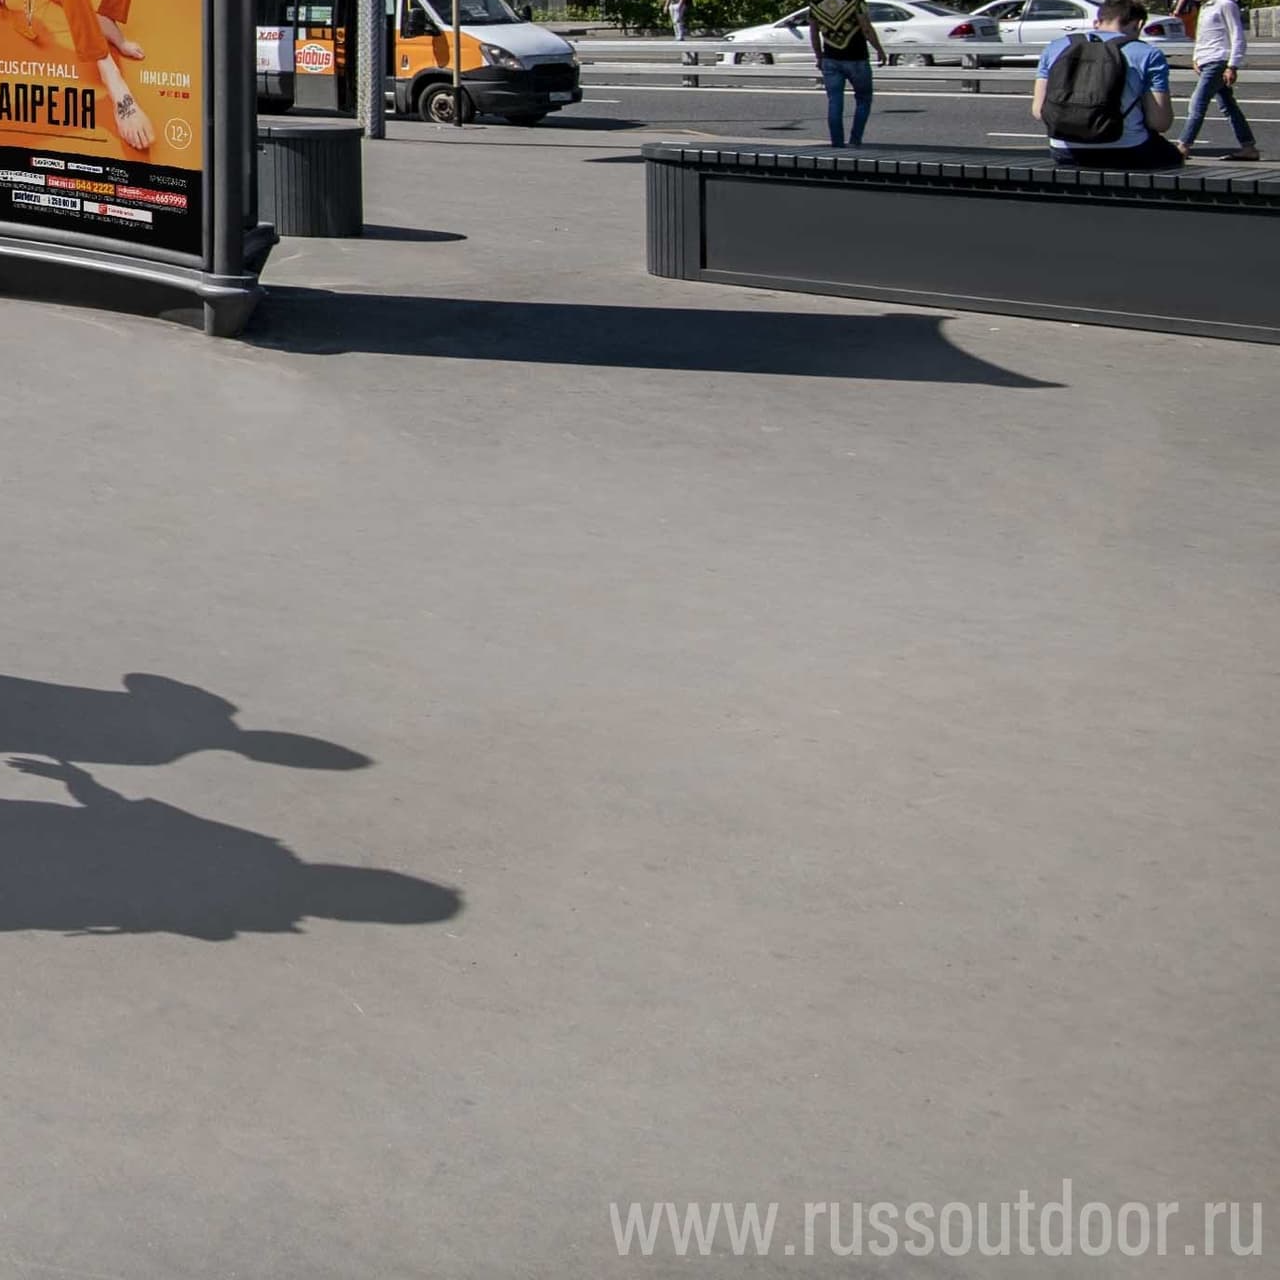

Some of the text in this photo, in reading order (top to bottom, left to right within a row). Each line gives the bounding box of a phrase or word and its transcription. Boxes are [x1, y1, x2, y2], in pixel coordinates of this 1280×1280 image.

[20, 60, 45, 77] CITY
[46, 63, 80, 80] HALL
[140, 69, 191, 89] IAMLP.COM
[171, 124, 189, 142] 12+
